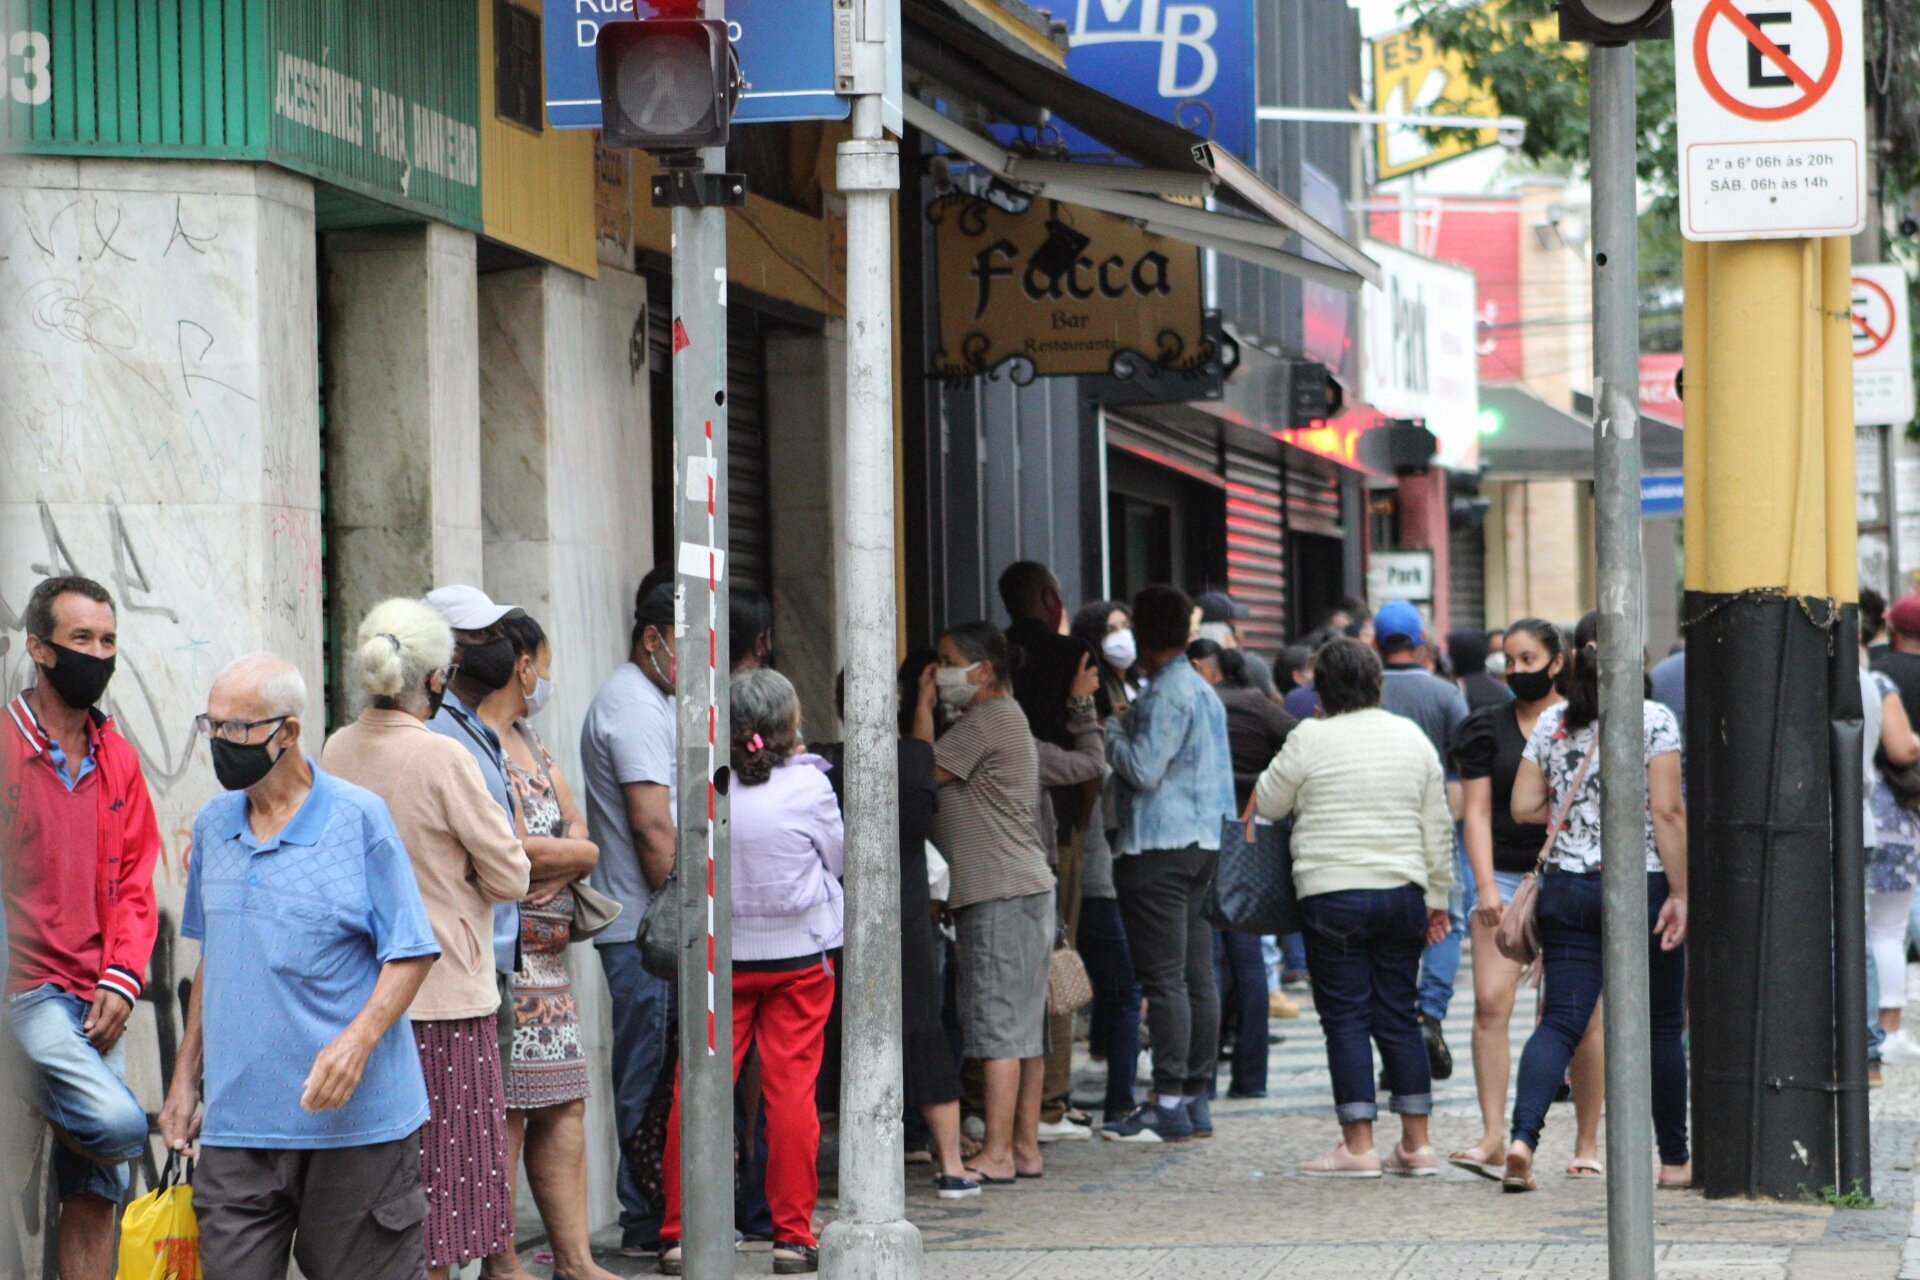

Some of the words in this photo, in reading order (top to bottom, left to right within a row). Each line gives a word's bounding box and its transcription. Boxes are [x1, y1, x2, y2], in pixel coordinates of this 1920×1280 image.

[0, 31, 51, 106] 3
[1746, 12, 1795, 89] E
[276, 47, 363, 147] ACESSÓRIOS
[372, 86, 406, 163] PARA
[1710, 177, 1747, 192] SÁB.
[1750, 178, 1776, 190] 06h
[1781, 177, 1798, 189] às
[1804, 176, 1829, 188] 14h
[1724, 161, 1733, 170] a
[1755, 156, 1781, 168] 06h
[1786, 155, 1802, 167] às
[1807, 154, 1834, 166] 20h
[1051, 309, 1089, 330] Bar
